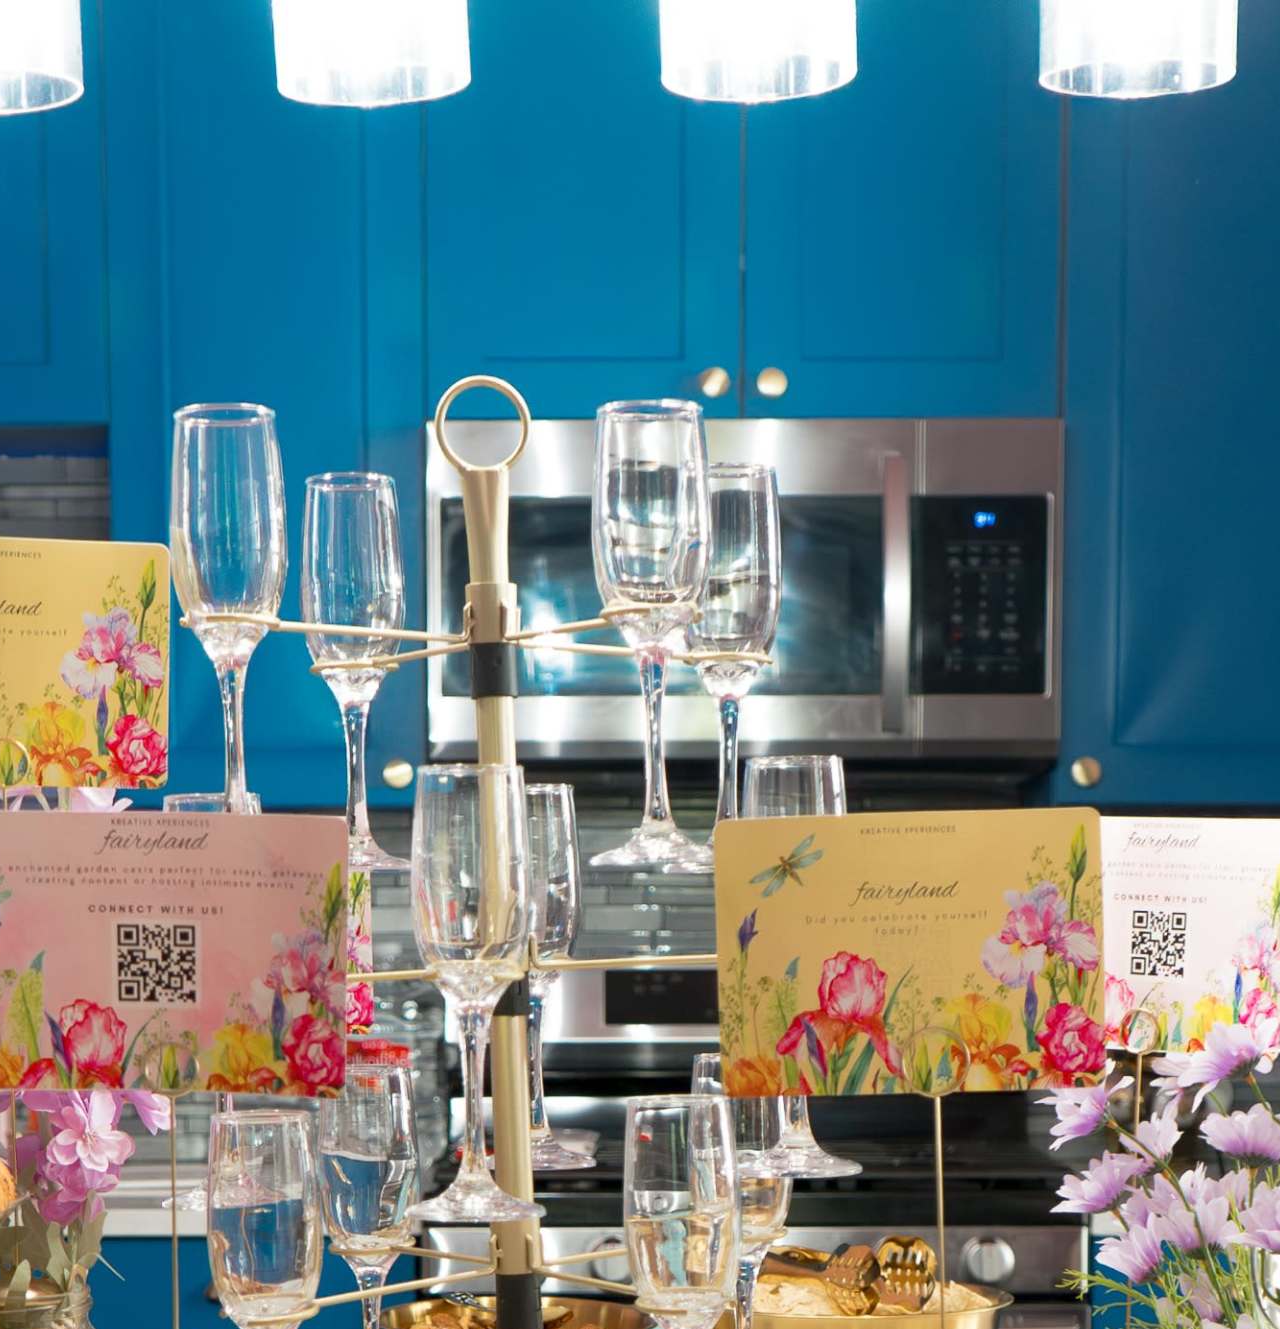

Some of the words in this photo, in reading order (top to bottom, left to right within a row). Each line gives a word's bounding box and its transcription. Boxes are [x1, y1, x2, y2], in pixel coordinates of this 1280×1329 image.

[20, 628, 68, 637] yourself
[94, 829, 209, 856] fairyland
[1123, 831, 1201, 854] fairyland
[8, 864, 71, 873] enchanted
[76, 864, 117, 874] garden
[134, 877, 146, 885] or
[151, 878, 195, 888] hosting
[848, 880, 960, 907] fairyland
[1113, 892, 1159, 901] CONNECT
[88, 904, 153, 913] CONNECT
[161, 905, 194, 914] WITH
[201, 906, 224, 915] US!
[805, 915, 826, 925] Did
[833, 915, 855, 925] you
[862, 913, 927, 923] celebrate
[934, 910, 989, 921] yourself
